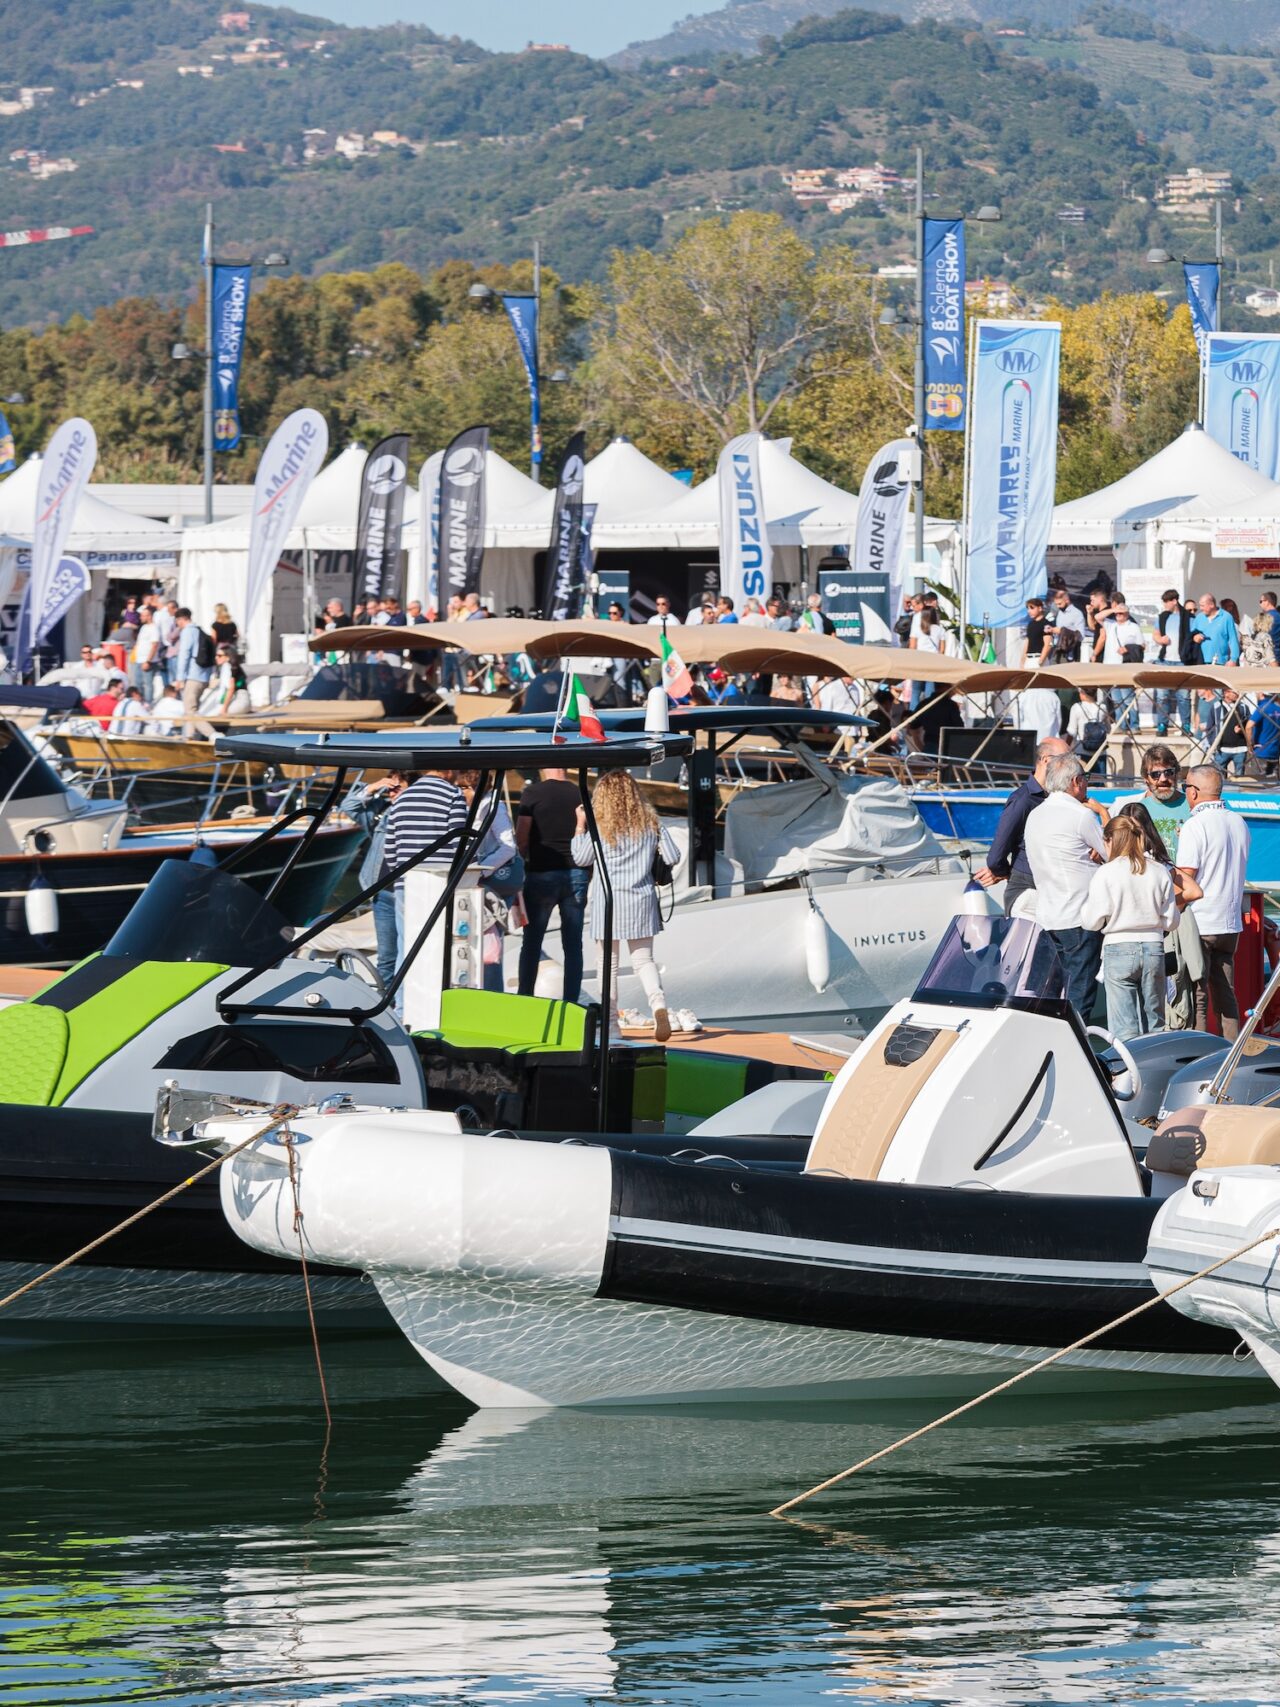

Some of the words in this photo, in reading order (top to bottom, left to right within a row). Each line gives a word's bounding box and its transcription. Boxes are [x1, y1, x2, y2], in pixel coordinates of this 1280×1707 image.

[944, 232, 960, 284] SHOW
[230, 276, 246, 322] SHOW
[930, 258, 946, 315] Salerno
[944, 287, 960, 332] BOAT
[217, 300, 232, 350] Salerno
[1012, 399, 1024, 442] MARINE
[1240, 407, 1251, 448] MARINE
[43, 429, 88, 509] Marine
[264, 420, 318, 501] Marine
[448, 499, 468, 588] MARINE
[732, 454, 765, 596] SUZUKI
[995, 445, 1021, 597] NOVAMARES
[87, 551, 147, 562] Panaro
[364, 507, 387, 596] MARINE
[555, 509, 572, 600] MARINE
[854, 930, 927, 948] INVICTUS
